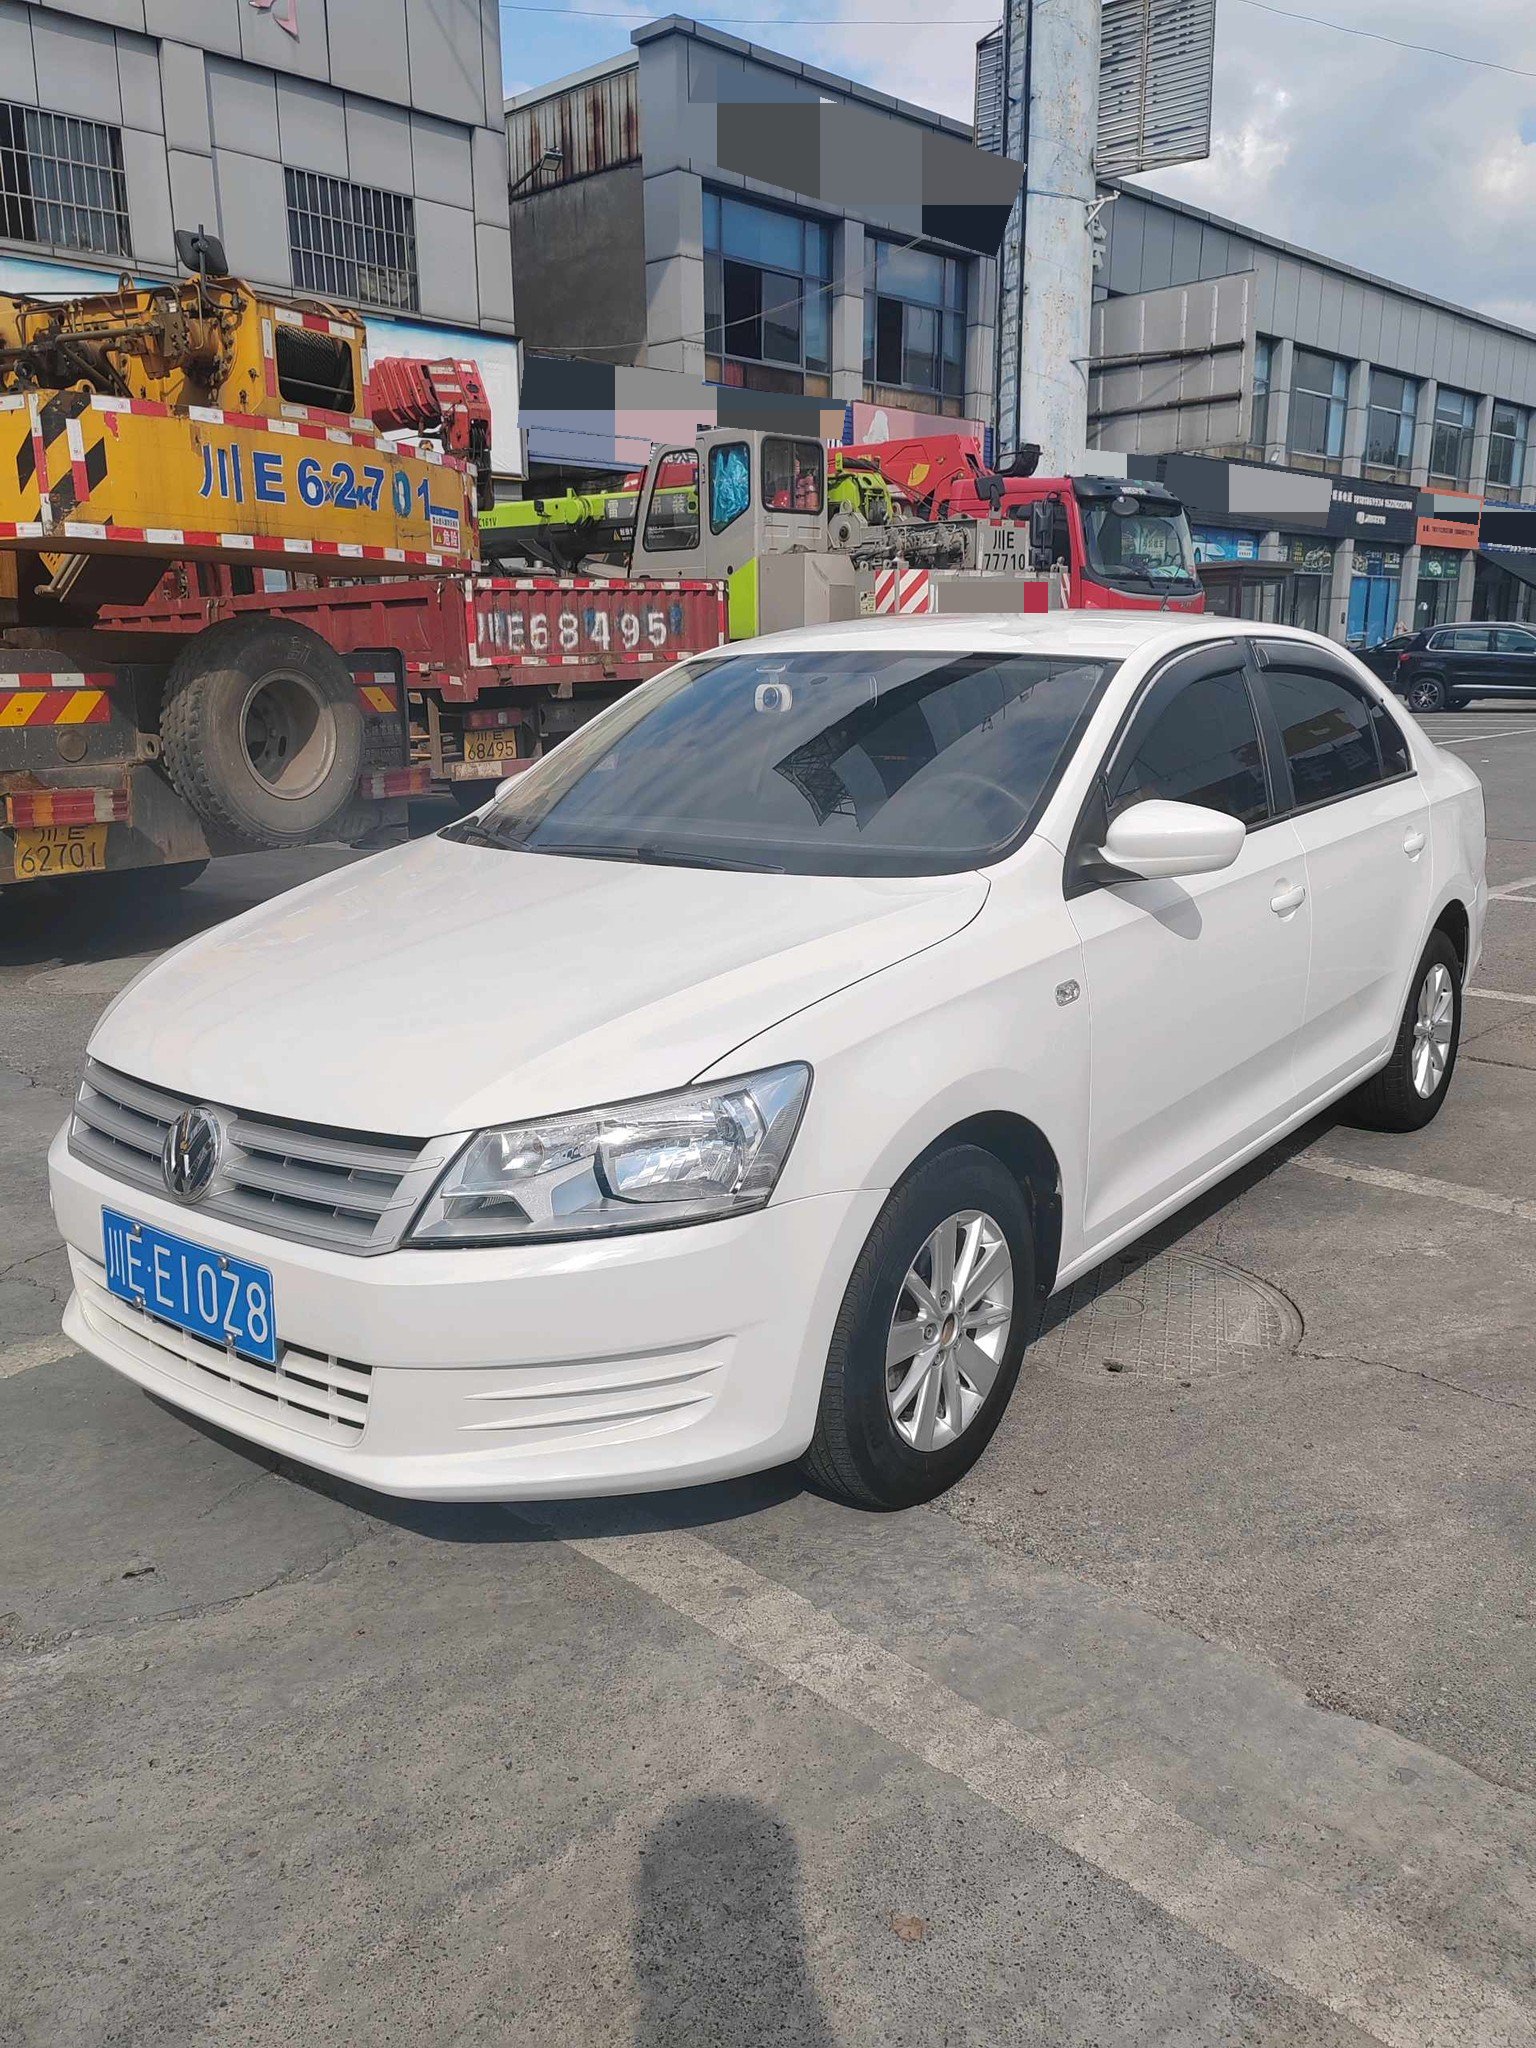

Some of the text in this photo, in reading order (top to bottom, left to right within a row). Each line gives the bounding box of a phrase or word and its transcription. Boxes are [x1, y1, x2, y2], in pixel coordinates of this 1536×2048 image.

[984, 553, 1026, 571] 77710
[467, 740, 514, 760] 68495
[21, 842, 97, 873] 62701
